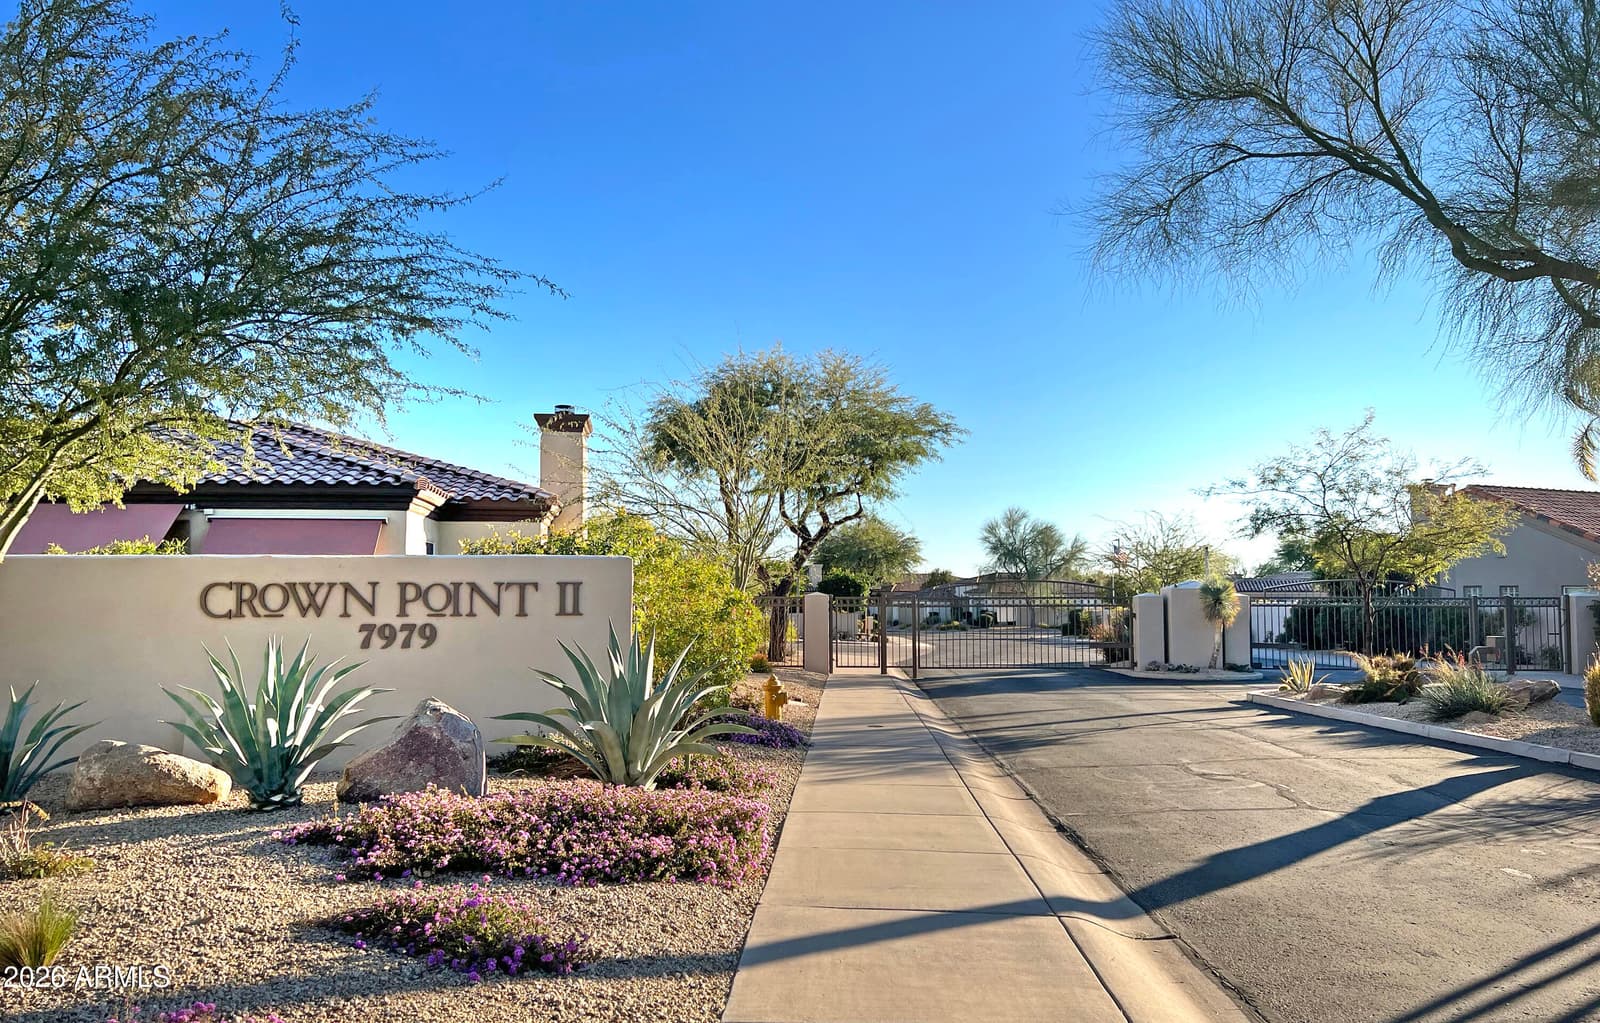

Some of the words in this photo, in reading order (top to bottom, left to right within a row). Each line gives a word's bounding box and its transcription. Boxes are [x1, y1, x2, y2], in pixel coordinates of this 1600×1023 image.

[199, 581, 380, 619] CROWN
[396, 581, 539, 618] POINT
[555, 581, 583, 616] II
[358, 623, 438, 650] 7979
